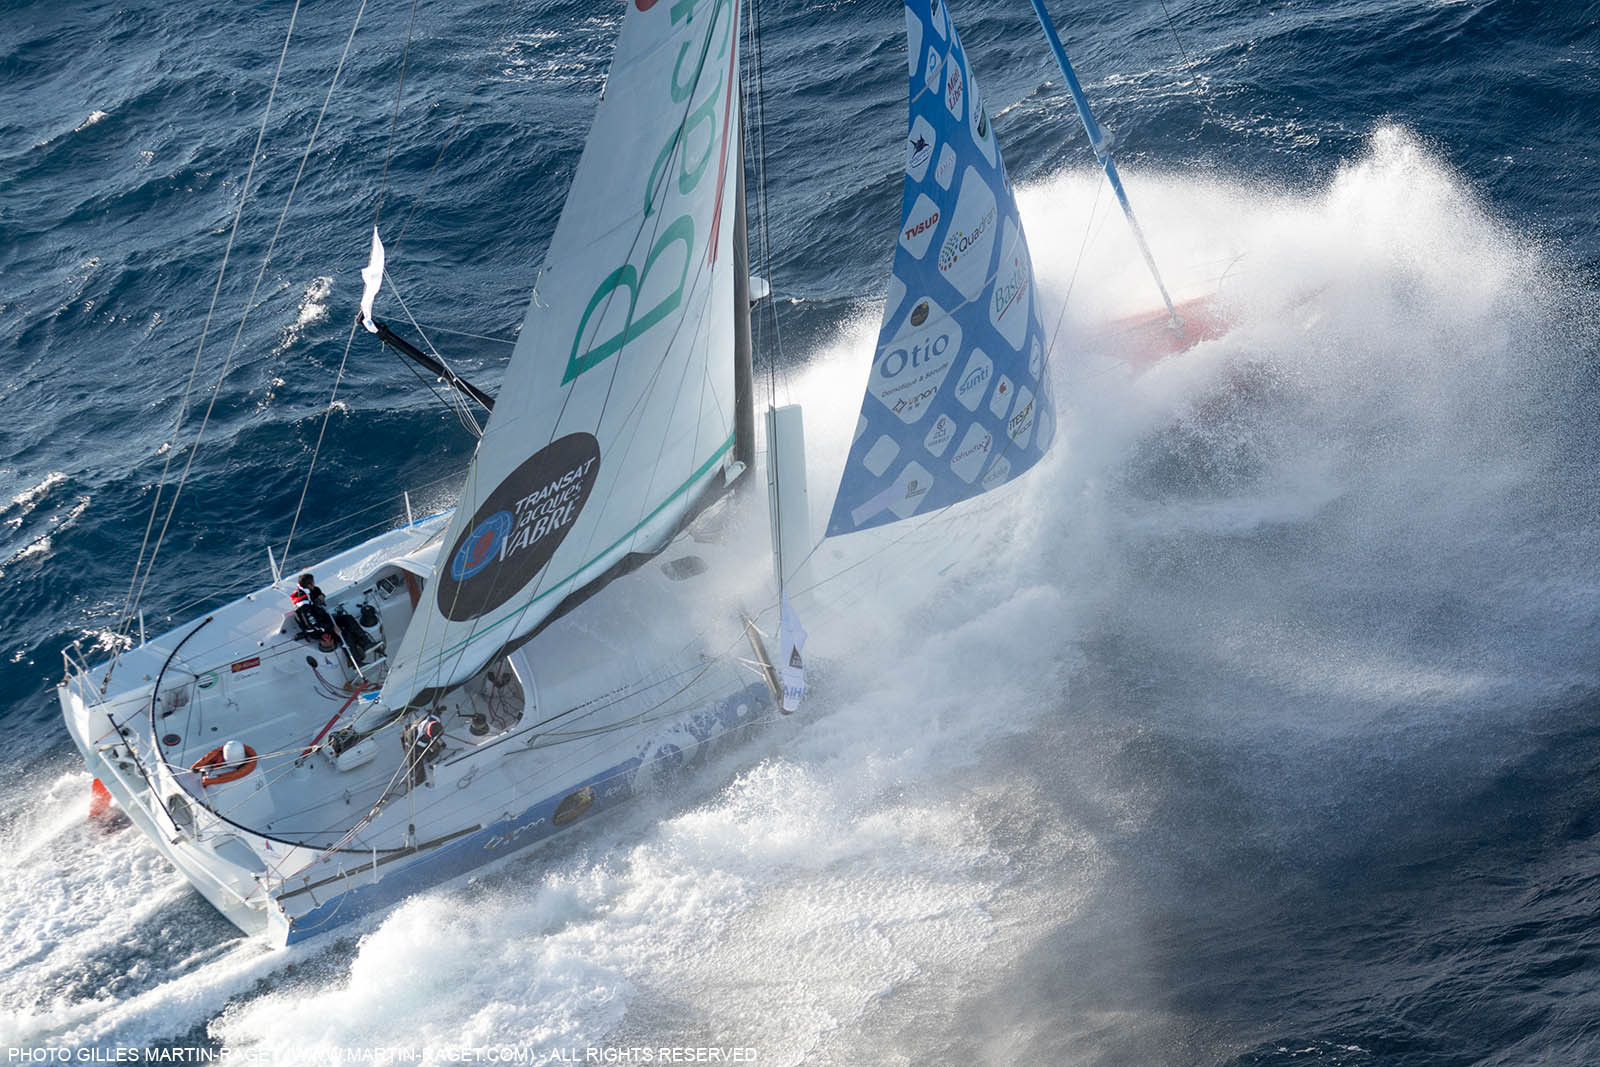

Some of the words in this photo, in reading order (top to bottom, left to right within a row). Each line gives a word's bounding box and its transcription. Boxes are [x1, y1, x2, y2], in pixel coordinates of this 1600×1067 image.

[958, 207, 996, 254] Quadran
[880, 334, 950, 378] Otio
[515, 457, 597, 515] TRANSAT
[499, 496, 582, 562] VABRE
